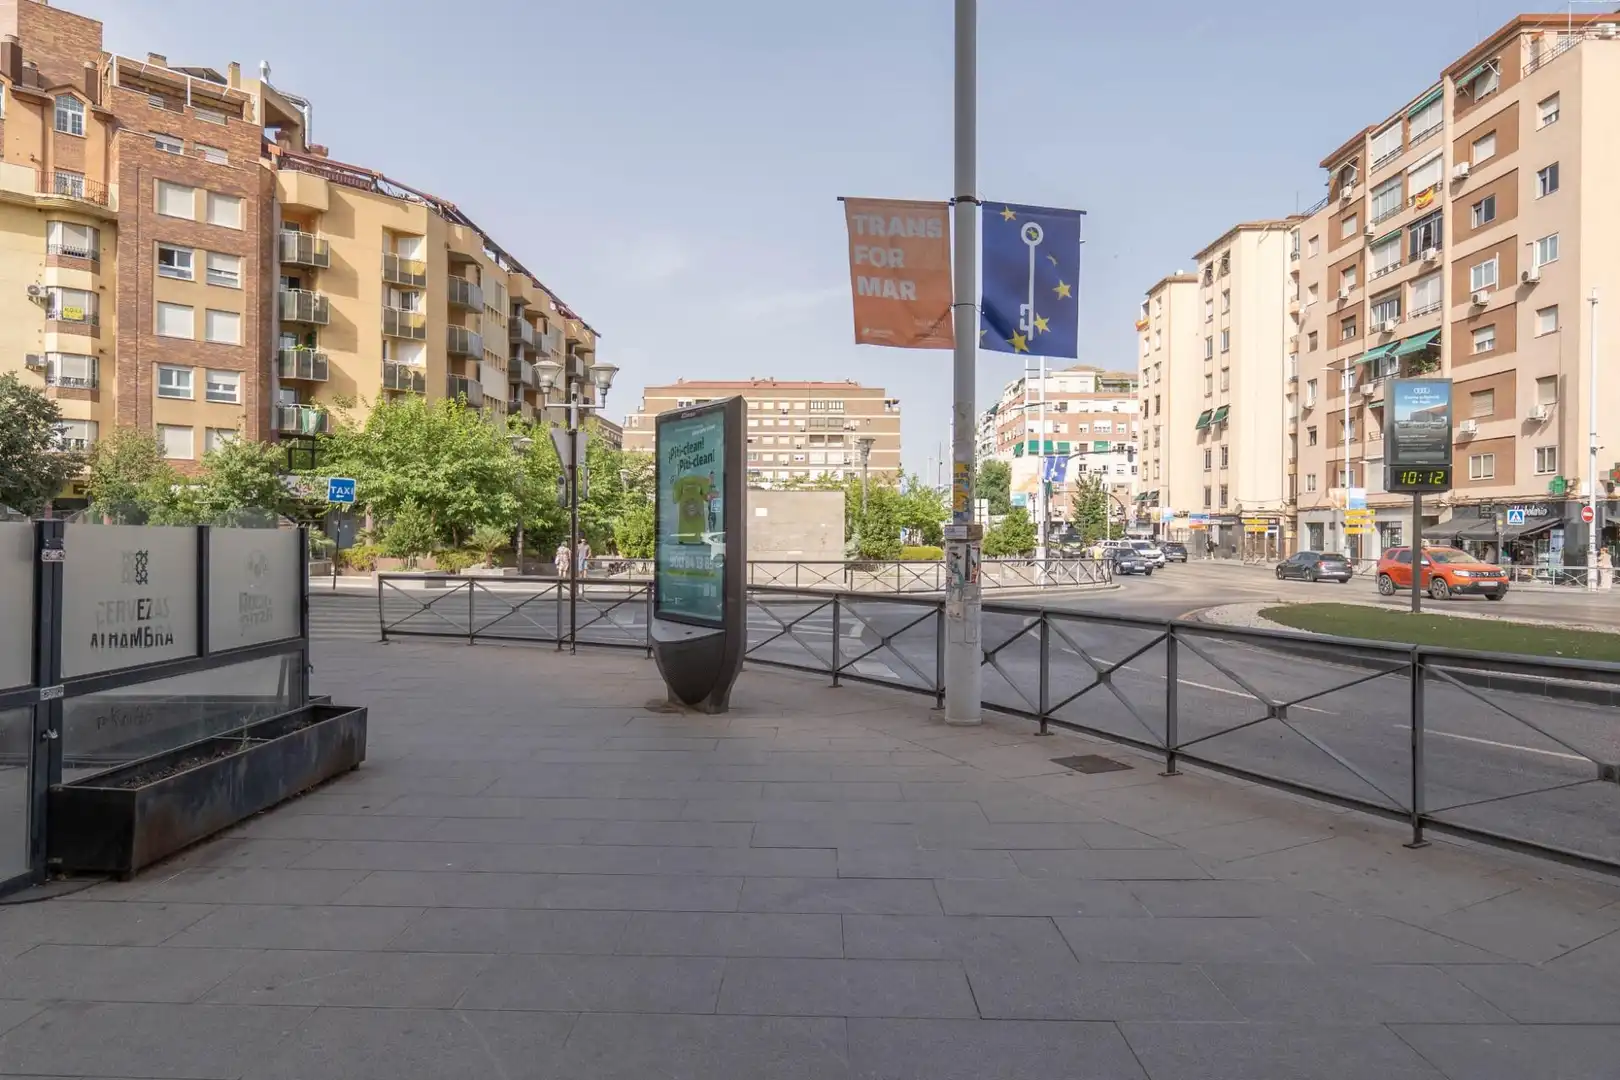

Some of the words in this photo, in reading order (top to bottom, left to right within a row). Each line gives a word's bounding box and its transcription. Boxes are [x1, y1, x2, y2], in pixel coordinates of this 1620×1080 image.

[852, 214, 942, 239] TRANS
[854, 245, 905, 269] FOR
[857, 275, 917, 301] MAR
[1400, 471, 1444, 485] 10:12
[330, 486, 354, 495] TAXI
[95, 598, 170, 628] CERVEZAS
